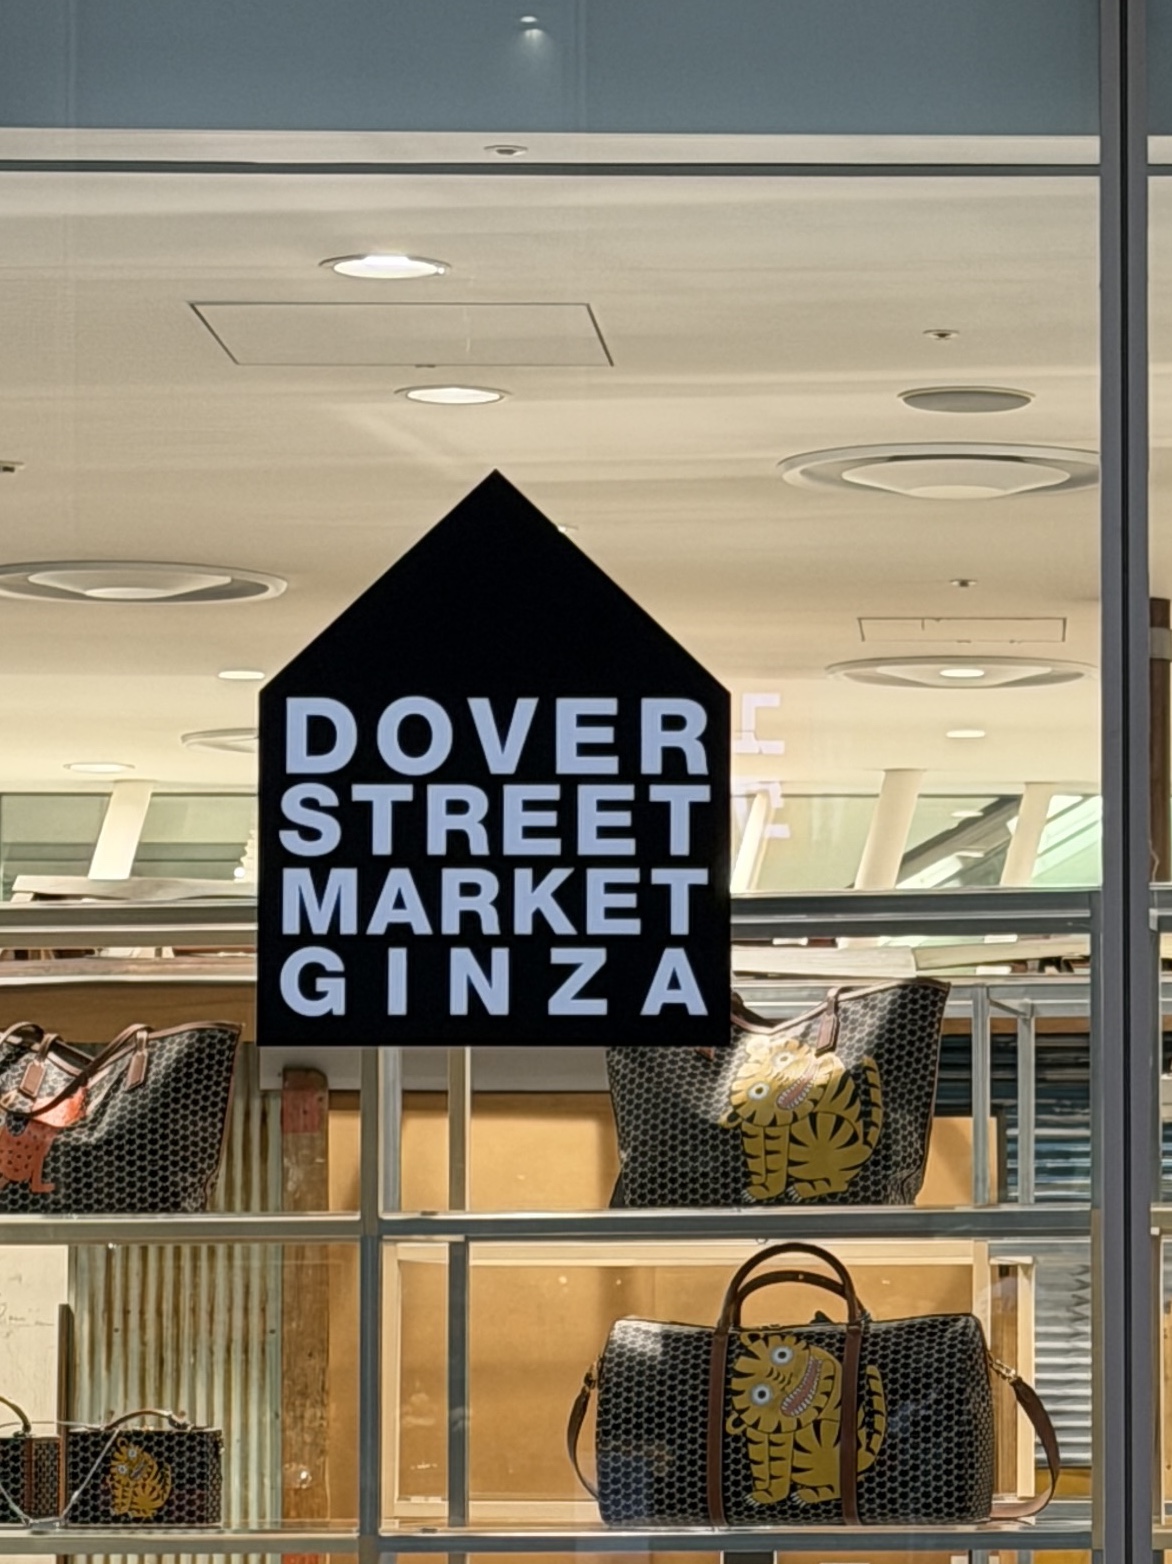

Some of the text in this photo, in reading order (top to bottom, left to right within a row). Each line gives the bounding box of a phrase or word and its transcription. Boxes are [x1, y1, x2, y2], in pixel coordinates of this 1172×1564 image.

[285, 695, 709, 776] DOVER
[278, 782, 711, 857] STREET
[282, 867, 709, 935] MARKET
[279, 946, 708, 1017] GINZA
